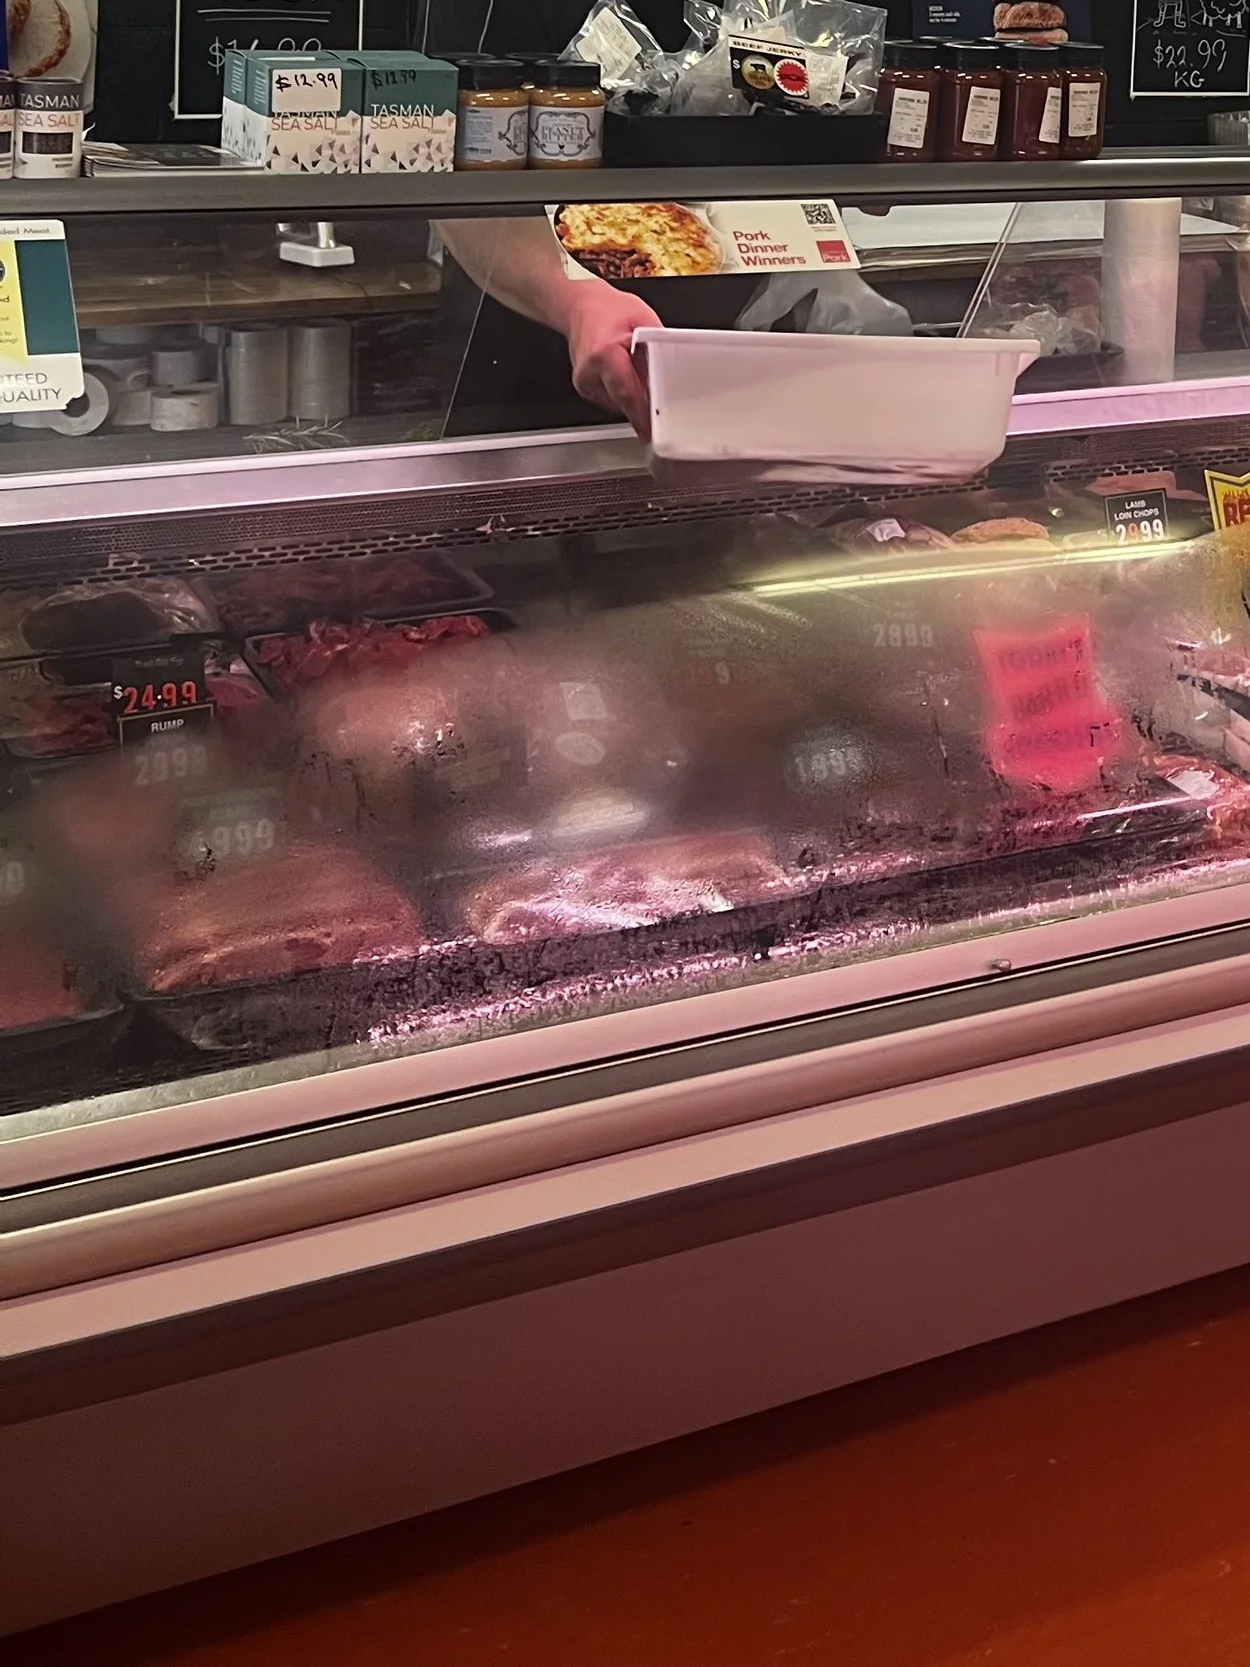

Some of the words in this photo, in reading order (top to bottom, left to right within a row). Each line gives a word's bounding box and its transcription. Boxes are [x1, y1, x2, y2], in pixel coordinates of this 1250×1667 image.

[733, 40, 764, 50] BEEF
[766, 46, 802, 58] JERKY
[1153, 38, 1227, 72] $22.99
[275, 72, 338, 93] $12.99
[371, 69, 417, 90] $12.99
[1174, 71, 1205, 88] KG
[21, 94, 80, 108] TASMAN
[371, 104, 435, 118] TASMAN
[19, 112, 44, 127] SEA
[47, 113, 79, 127] SALT
[271, 116, 300, 131] SEA
[304, 117, 338, 132] SALT
[370, 116, 398, 131] SEA
[402, 116, 435, 132] SALT
[732, 229, 771, 242] Pork
[737, 242, 789, 254] Dinner
[741, 255, 807, 267] Winners
[1125, 499, 1147, 509] LAMB
[1114, 511, 1132, 521] LOIN
[1133, 507, 1160, 519] CHOPS
[113, 680, 197, 715] $24.99
[151, 718, 185, 734] RUMP
